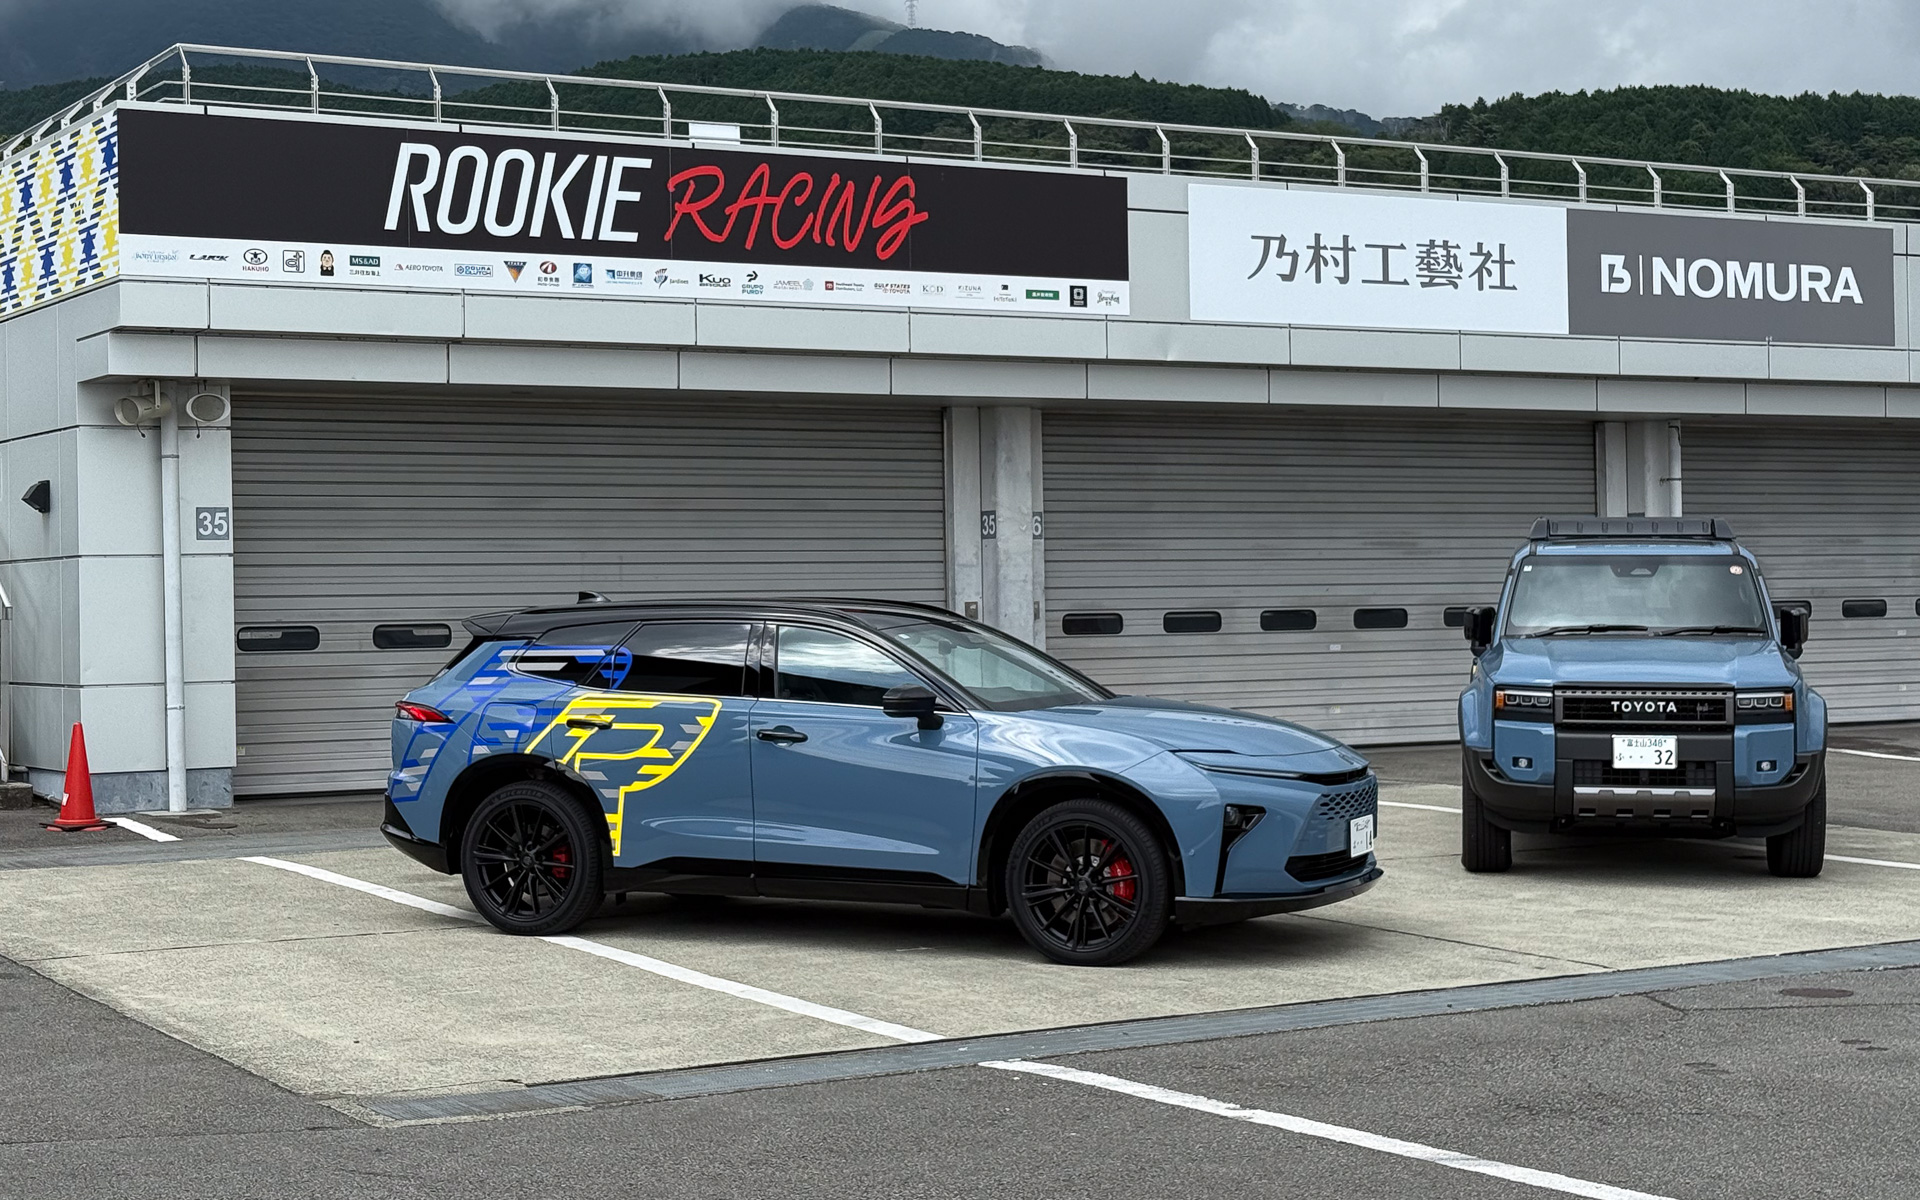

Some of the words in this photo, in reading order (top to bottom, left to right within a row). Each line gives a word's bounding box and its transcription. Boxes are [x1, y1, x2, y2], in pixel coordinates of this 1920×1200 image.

[385, 142, 653, 243] ROOKIE
[665, 164, 928, 259] RACING
[351, 257, 379, 265] MS&AD
[1248, 233, 1517, 291] 乃村工藝社
[1653, 257, 1863, 304] NOMURA
[199, 512, 227, 535] 35
[982, 515, 995, 535] 35
[1033, 516, 1042, 536] 6
[1611, 701, 1677, 713] TOYOTA
[1654, 749, 1673, 766] 32
